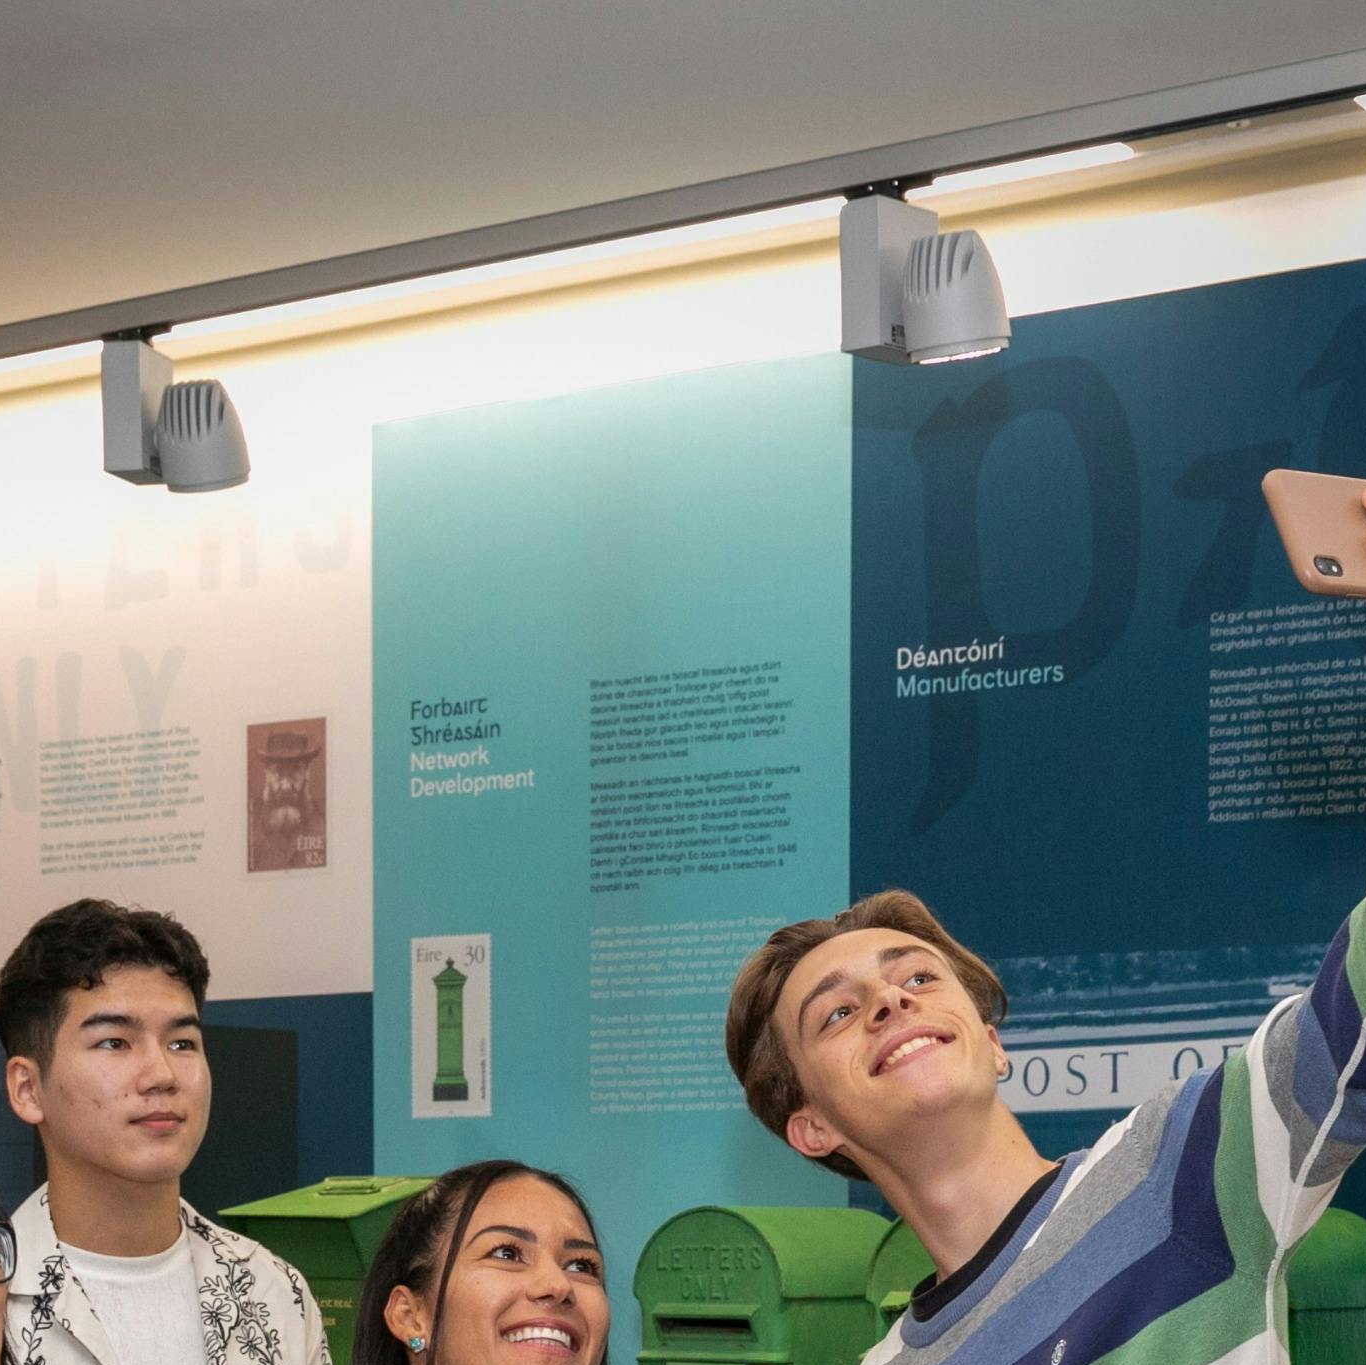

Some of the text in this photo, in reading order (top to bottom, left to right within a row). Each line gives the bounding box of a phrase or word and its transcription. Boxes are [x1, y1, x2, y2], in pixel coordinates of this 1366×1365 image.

[896, 635, 1004, 669] Déantóirí
[896, 664, 1063, 698] Manufacturers
[410, 696, 487, 720] Forbairt
[410, 718, 501, 747] Shréasáin
[410, 743, 490, 772] Network
[410, 767, 534, 797] Development
[463, 944, 485, 966] 30
[655, 1244, 762, 1271] LETTERS
[681, 1273, 734, 1301] ONLY
